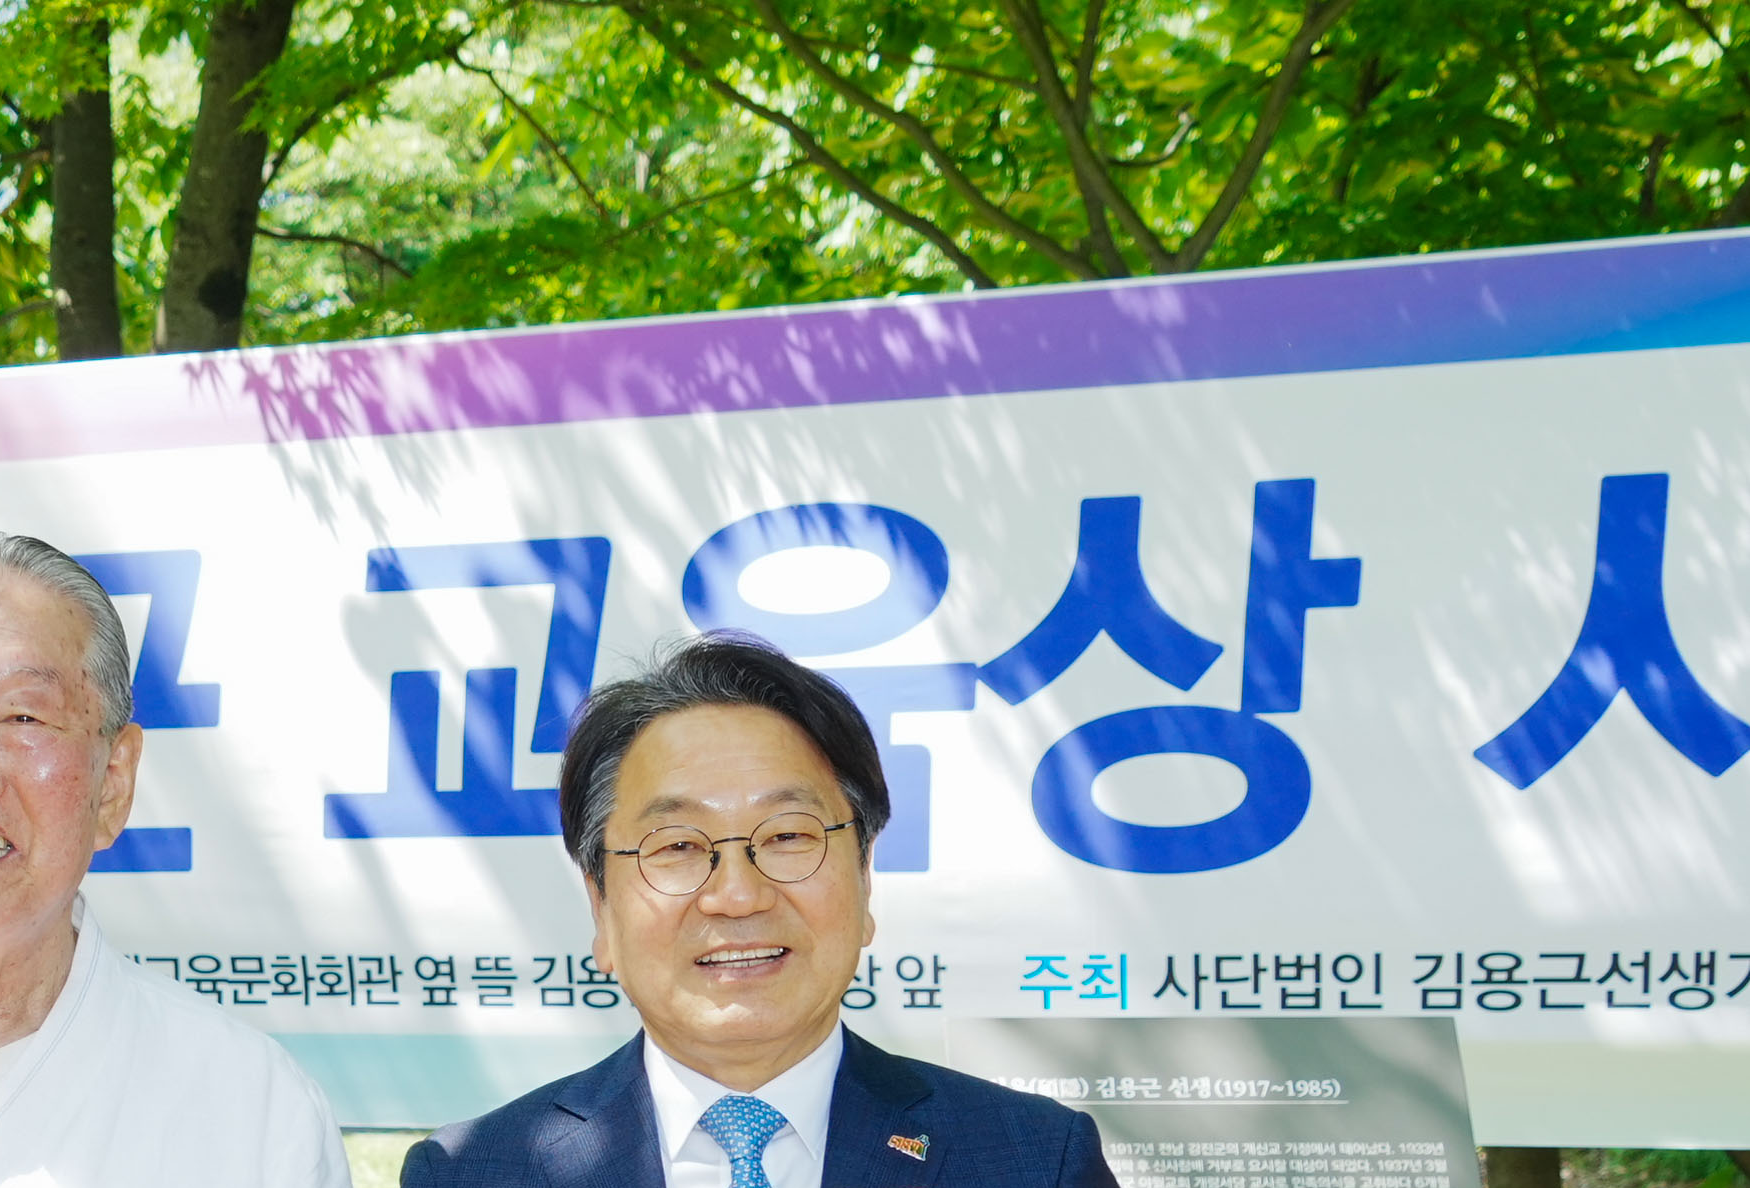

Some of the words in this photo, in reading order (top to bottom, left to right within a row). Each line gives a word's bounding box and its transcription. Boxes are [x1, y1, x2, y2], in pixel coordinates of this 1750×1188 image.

[324, 477, 1360, 875] 교육상
[415, 954, 457, 1008] 옆
[471, 954, 519, 1008] 뜰
[896, 953, 947, 1010] 앞
[1018, 952, 1130, 1011] 주최
[1152, 951, 1384, 1011] 사단법인
[1096, 1077, 1162, 1098] 김용근
[1111, 1142, 1154, 1156] 1917년
[1159, 1142, 1184, 1156] 전남
[1208, 1159, 1245, 1173] 거부로
[1289, 1159, 1328, 1173] 대상이
